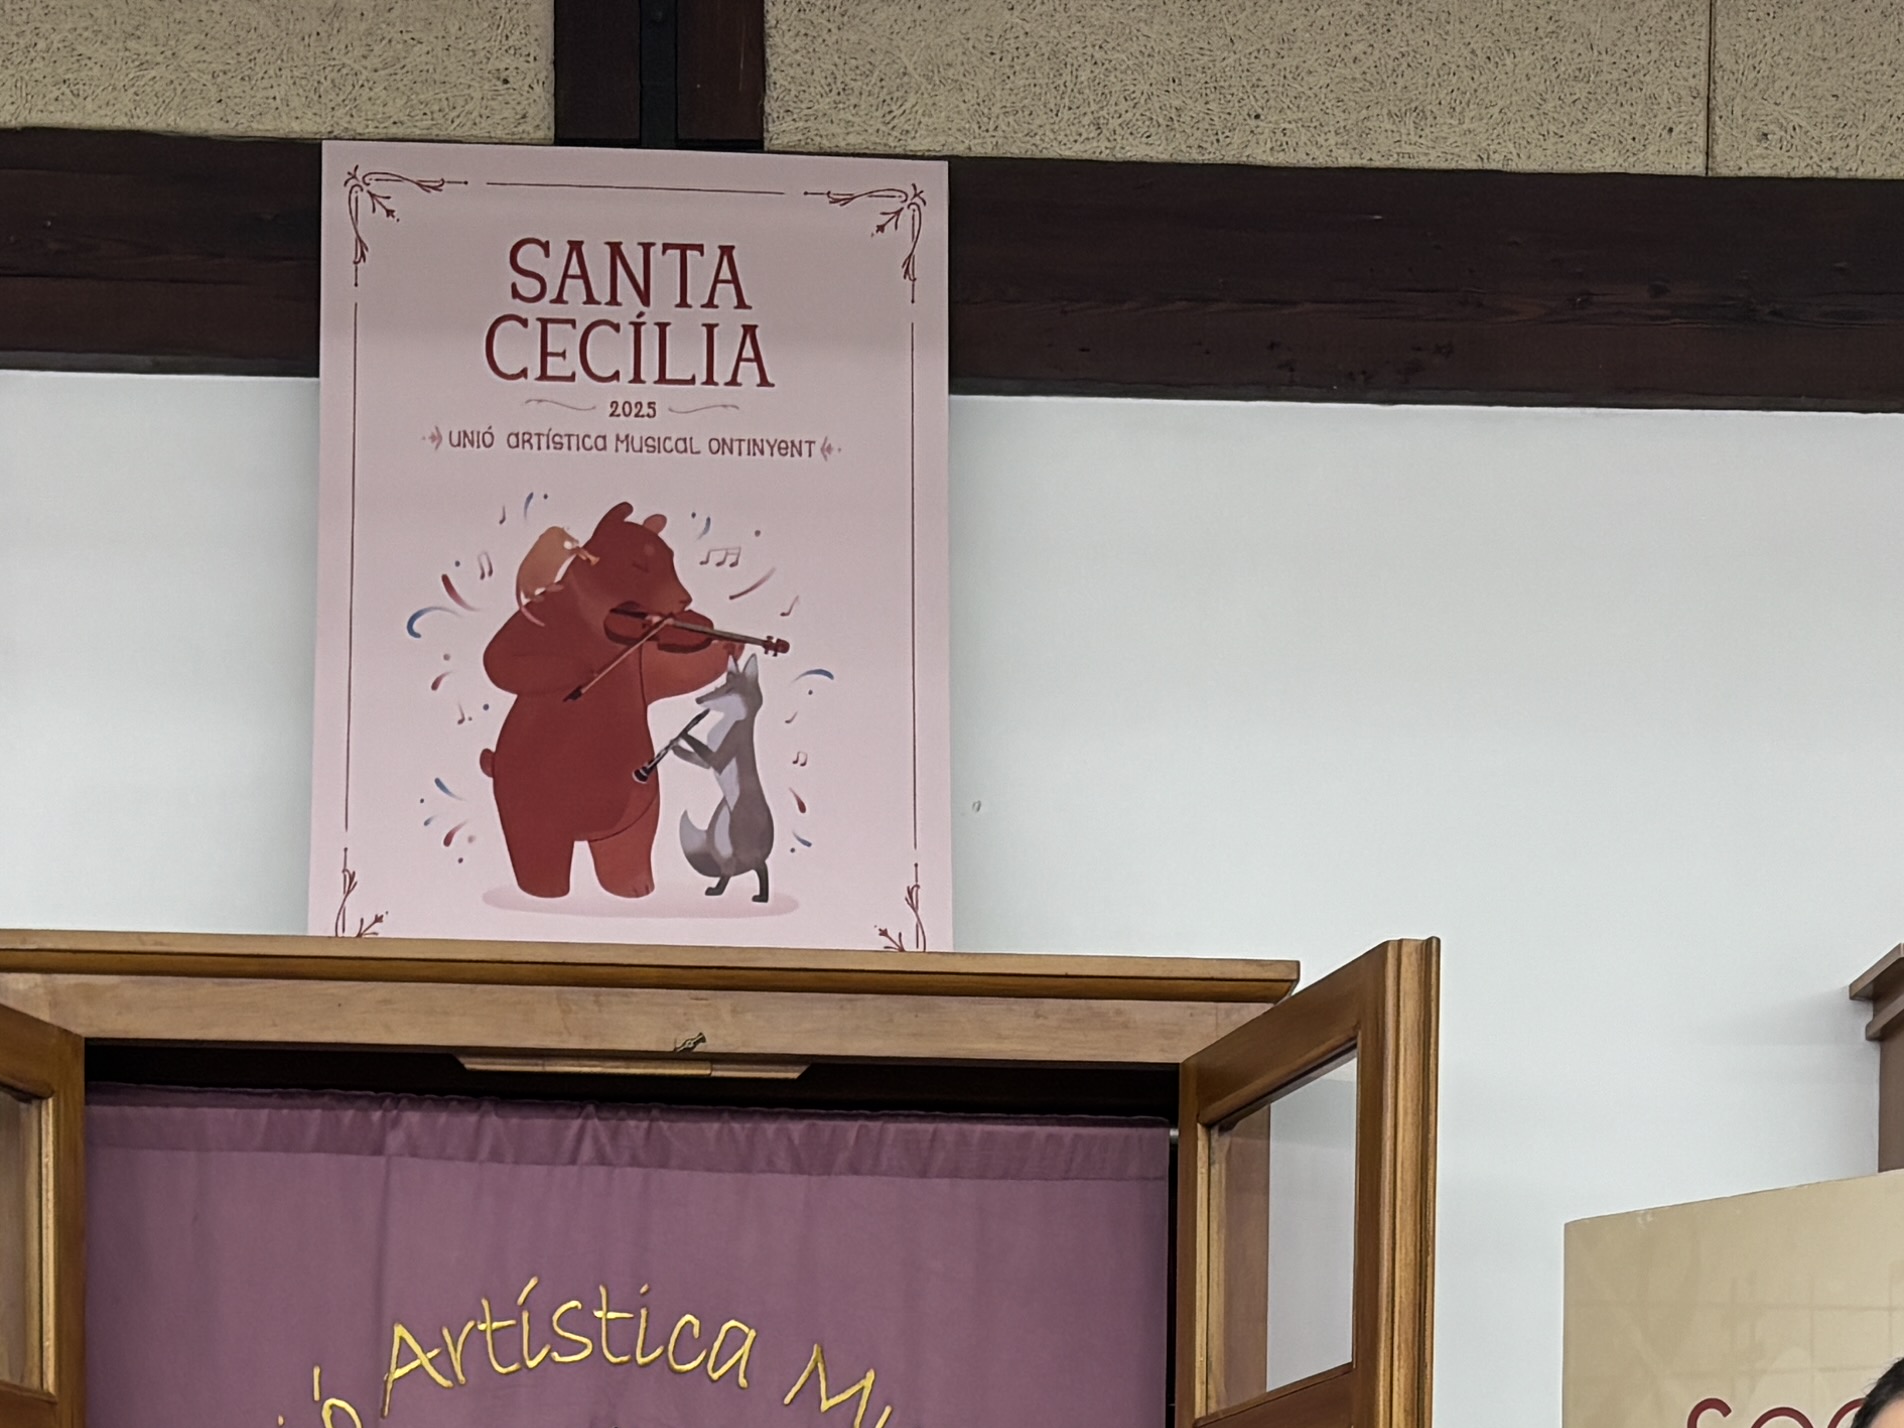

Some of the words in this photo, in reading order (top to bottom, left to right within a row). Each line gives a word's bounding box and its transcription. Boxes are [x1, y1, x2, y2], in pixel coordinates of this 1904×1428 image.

[509, 237, 753, 311] SANTA
[485, 311, 776, 388] CECÍLIA
[448, 425, 495, 449] UNIÓ
[608, 400, 657, 419] 2025
[383, 1277, 758, 1418] Artística
